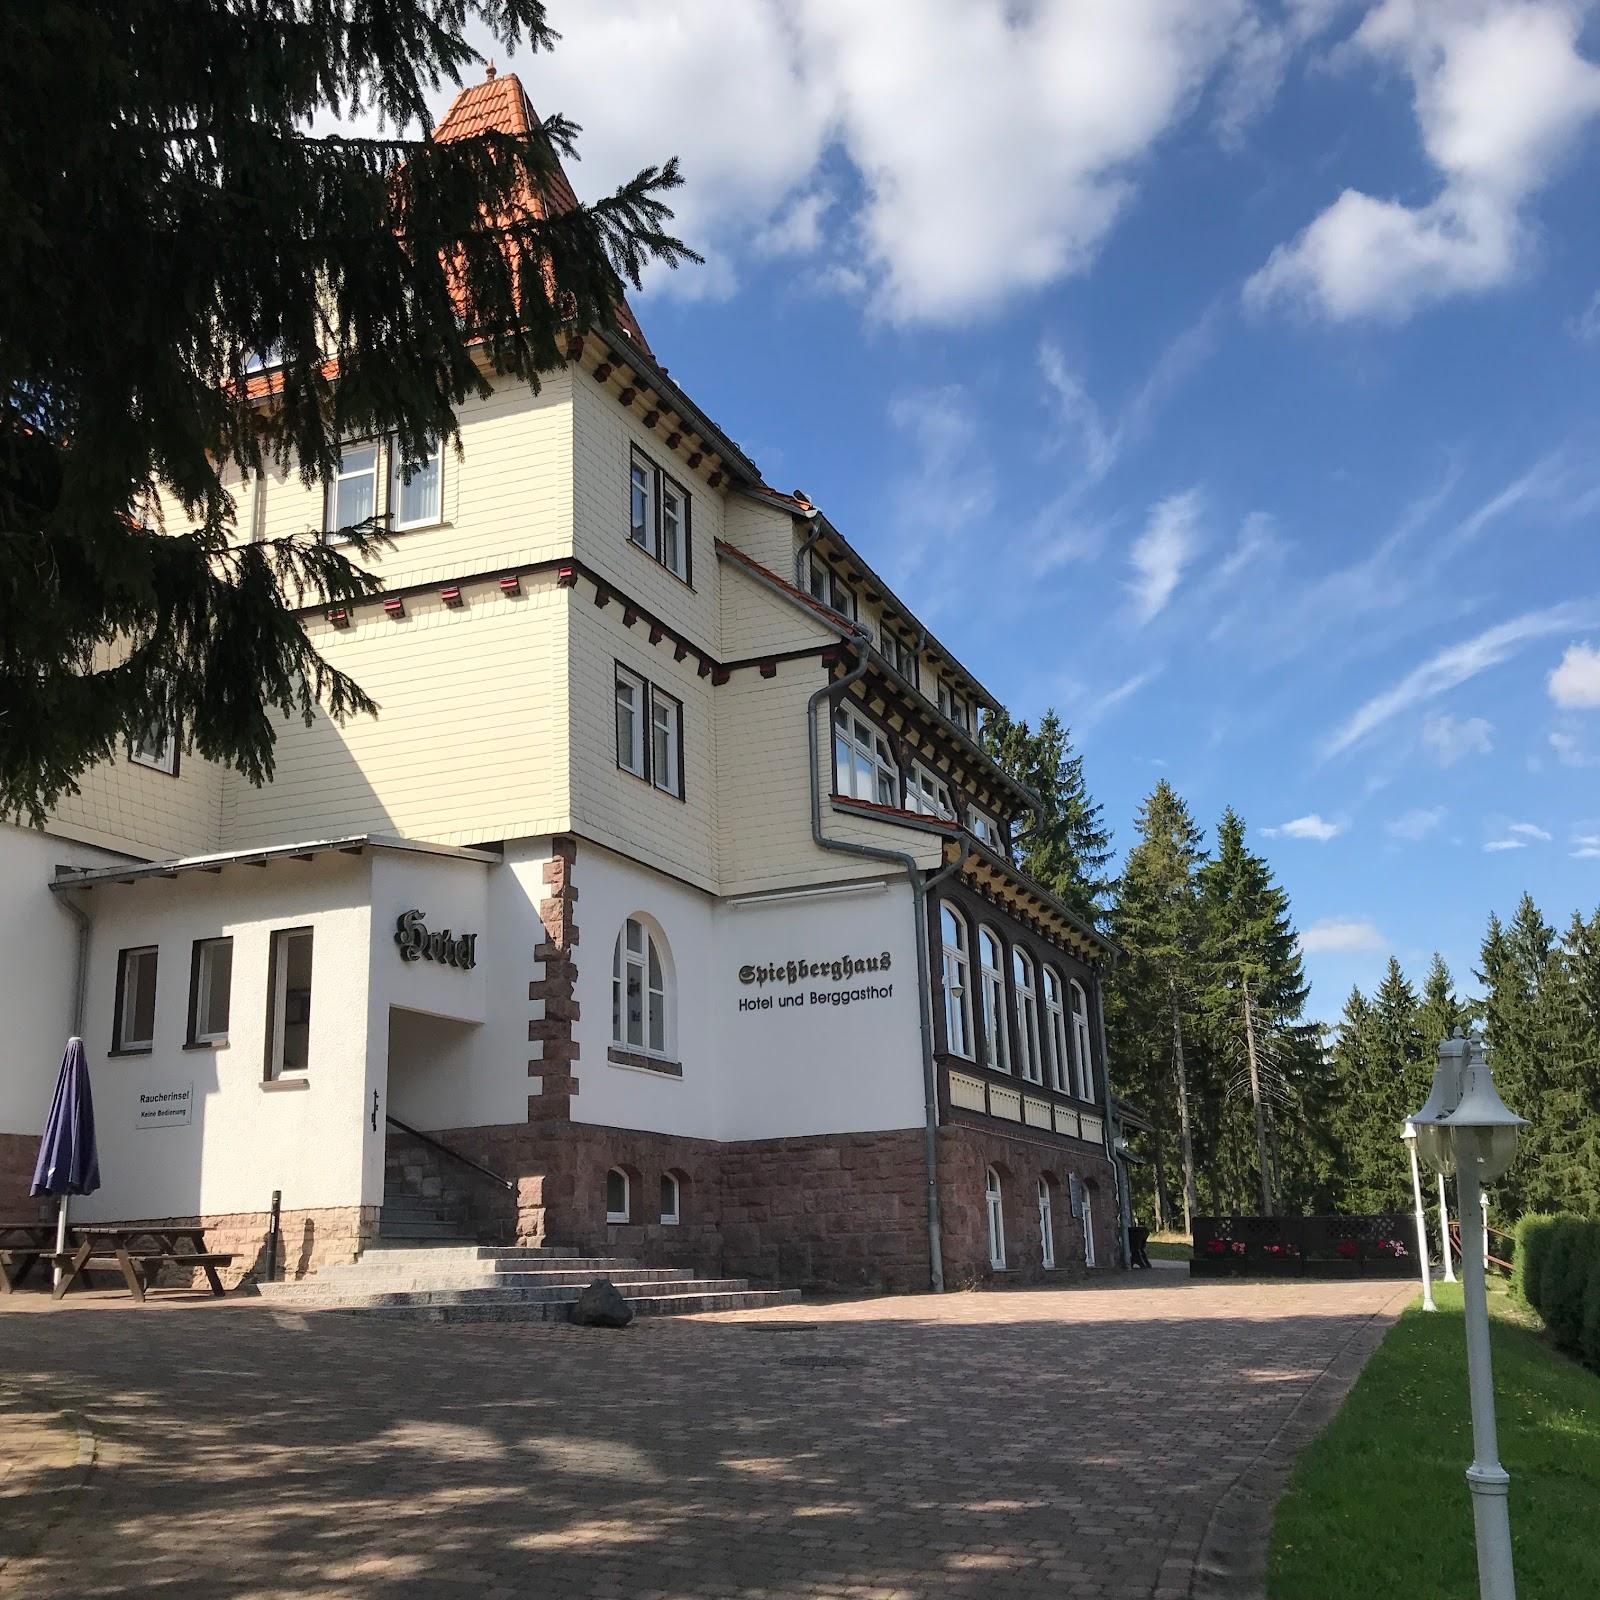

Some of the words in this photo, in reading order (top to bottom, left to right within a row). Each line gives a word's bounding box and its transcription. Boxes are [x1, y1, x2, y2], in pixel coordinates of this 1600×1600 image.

[394, 909, 478, 970] Hotel
[738, 951, 893, 988] Spießberghaus
[739, 996, 773, 1012] Hotel
[778, 993, 804, 1008] und
[810, 984, 893, 1006] Berggasthof
[140, 1091, 190, 1103] Raucherinsel
